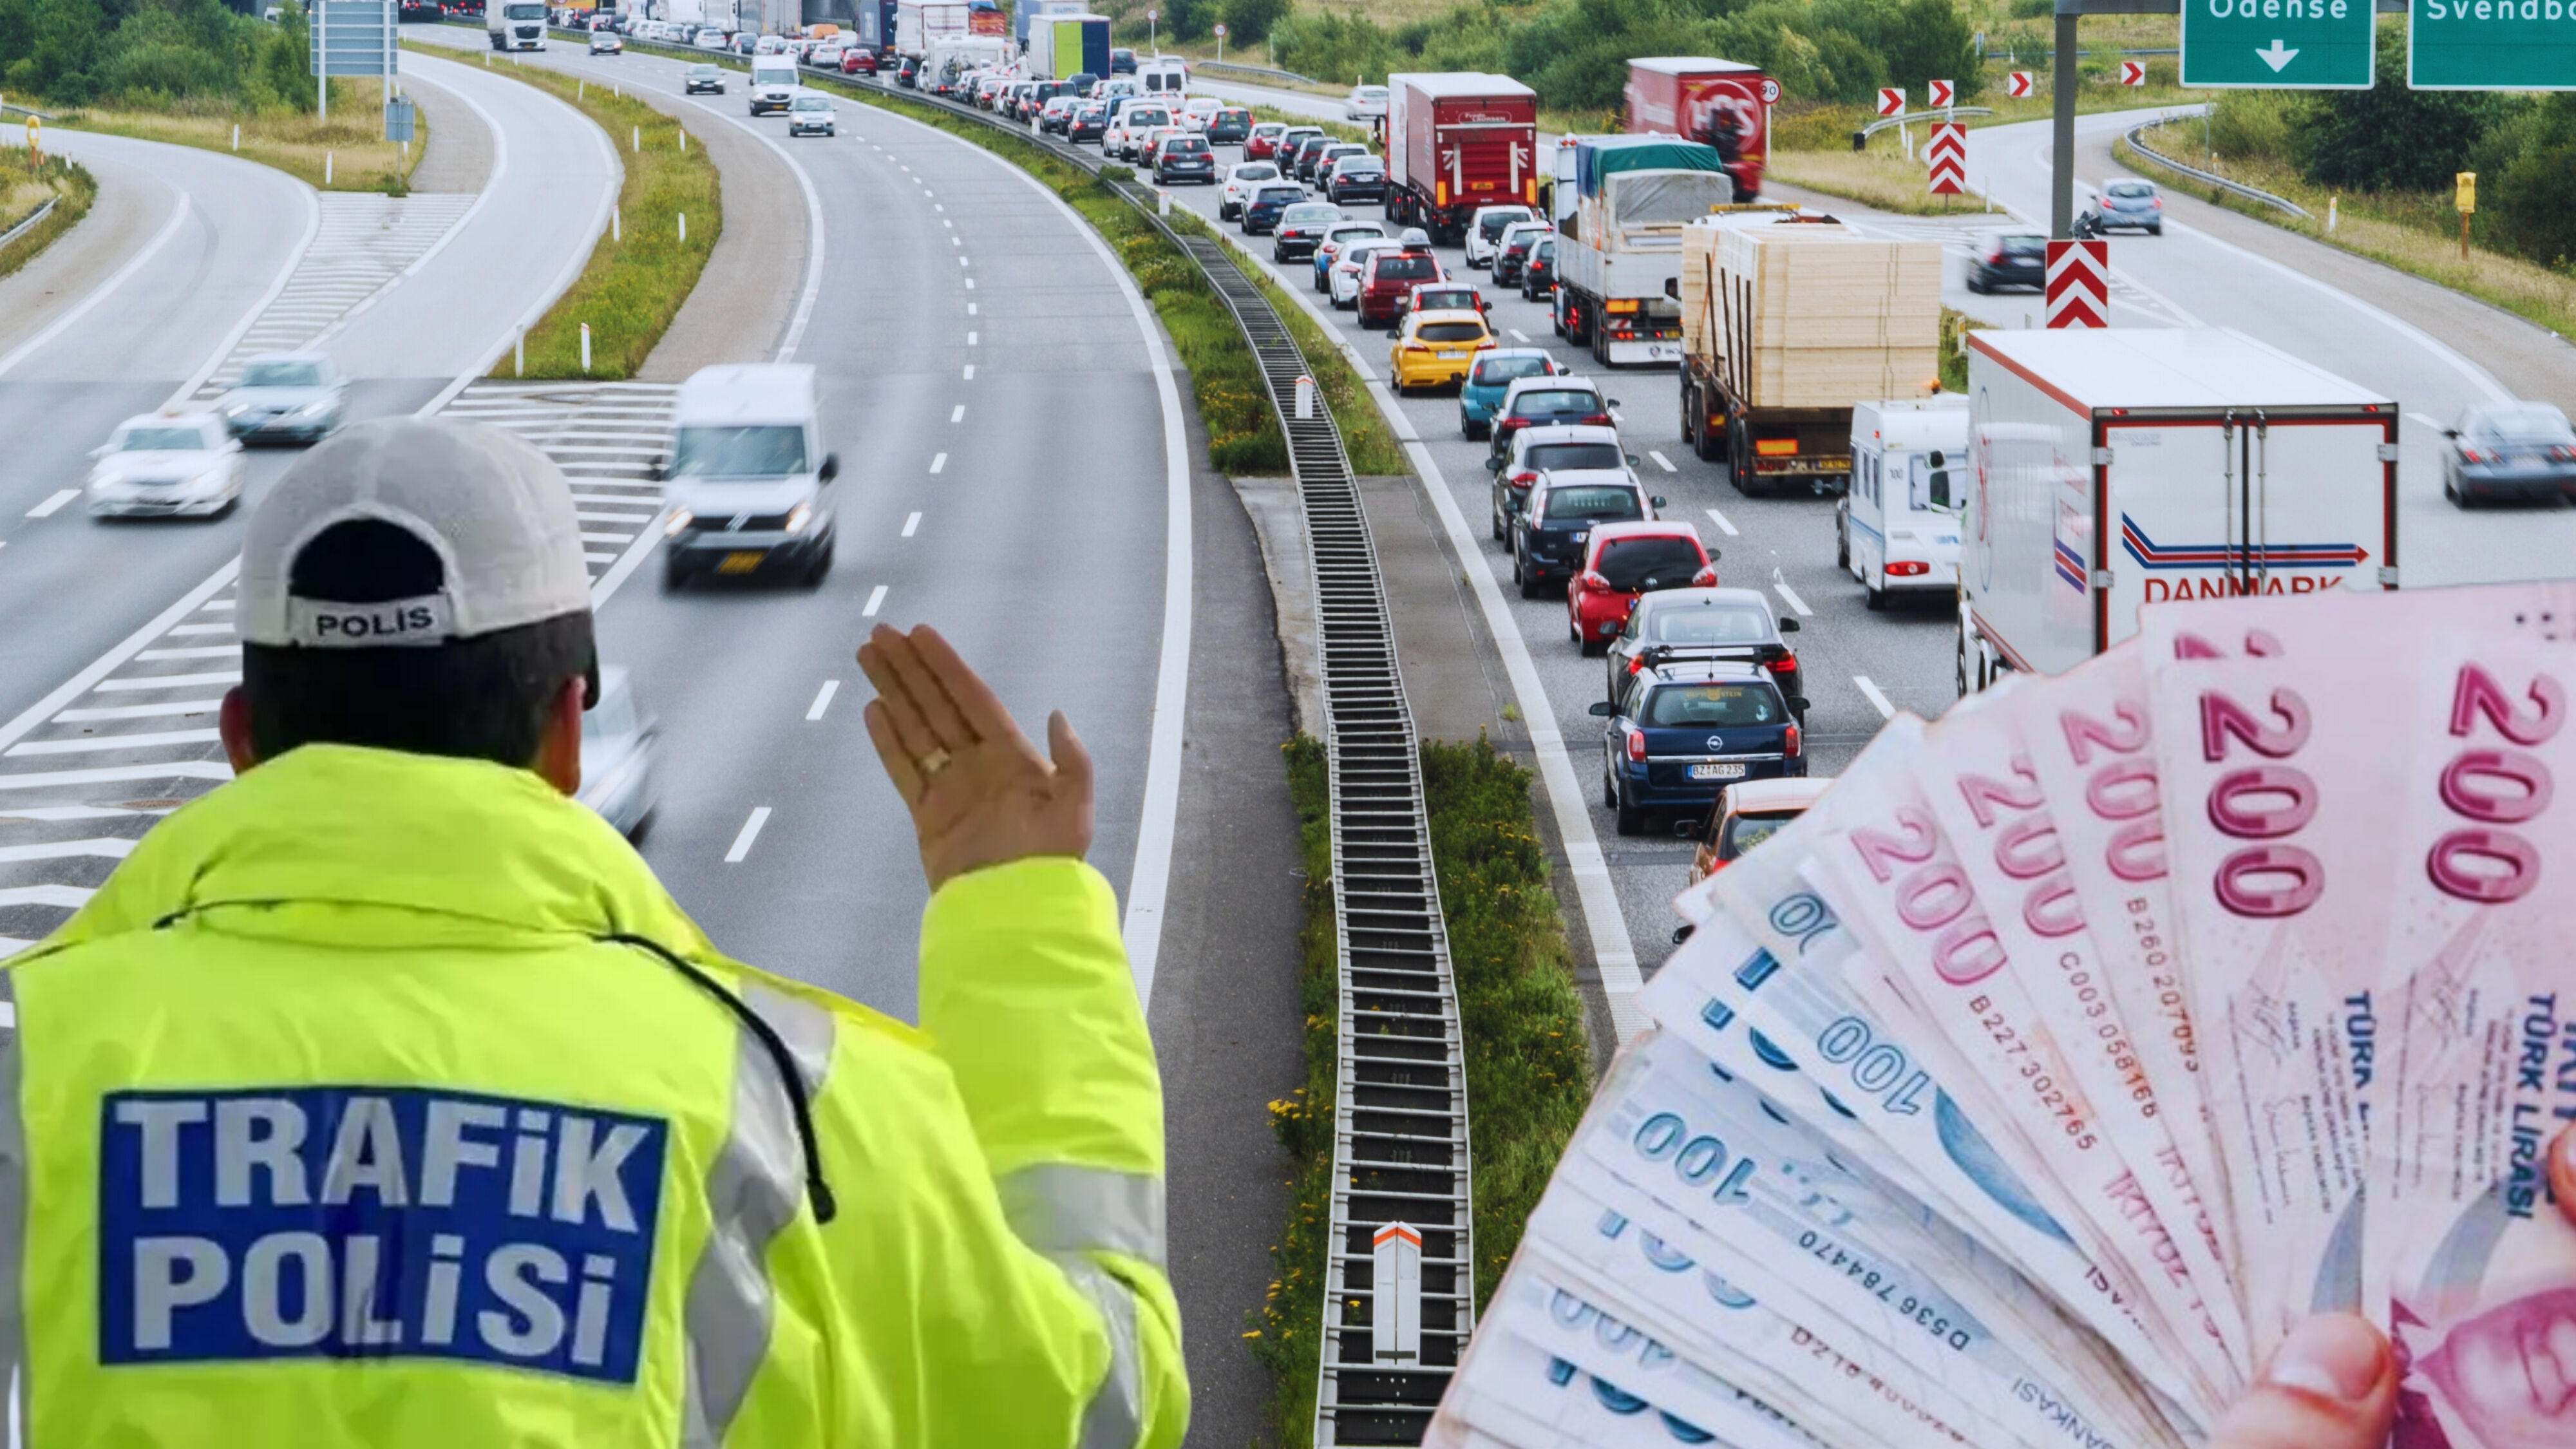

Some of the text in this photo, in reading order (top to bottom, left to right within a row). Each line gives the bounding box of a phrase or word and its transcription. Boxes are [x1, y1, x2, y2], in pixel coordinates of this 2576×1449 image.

[1760, 85, 1777, 95] 90
[1712, 764, 1725, 774] AG
[1726, 764, 1744, 774] 235
[2199, 686, 2325, 919] 200
[2425, 661, 2567, 905] 200
[1849, 806, 2009, 986] 200
[2126, 897, 2166, 966] B260
[2058, 951, 2107, 1019] C003
[1969, 994, 2098, 1151] B227 302765
[2516, 992, 2557, 1094] TÜRK
[1634, 1112, 1756, 1206] 100
[1798, 1229, 1897, 1302] 784470
[1899, 1296, 1971, 1351] D536
